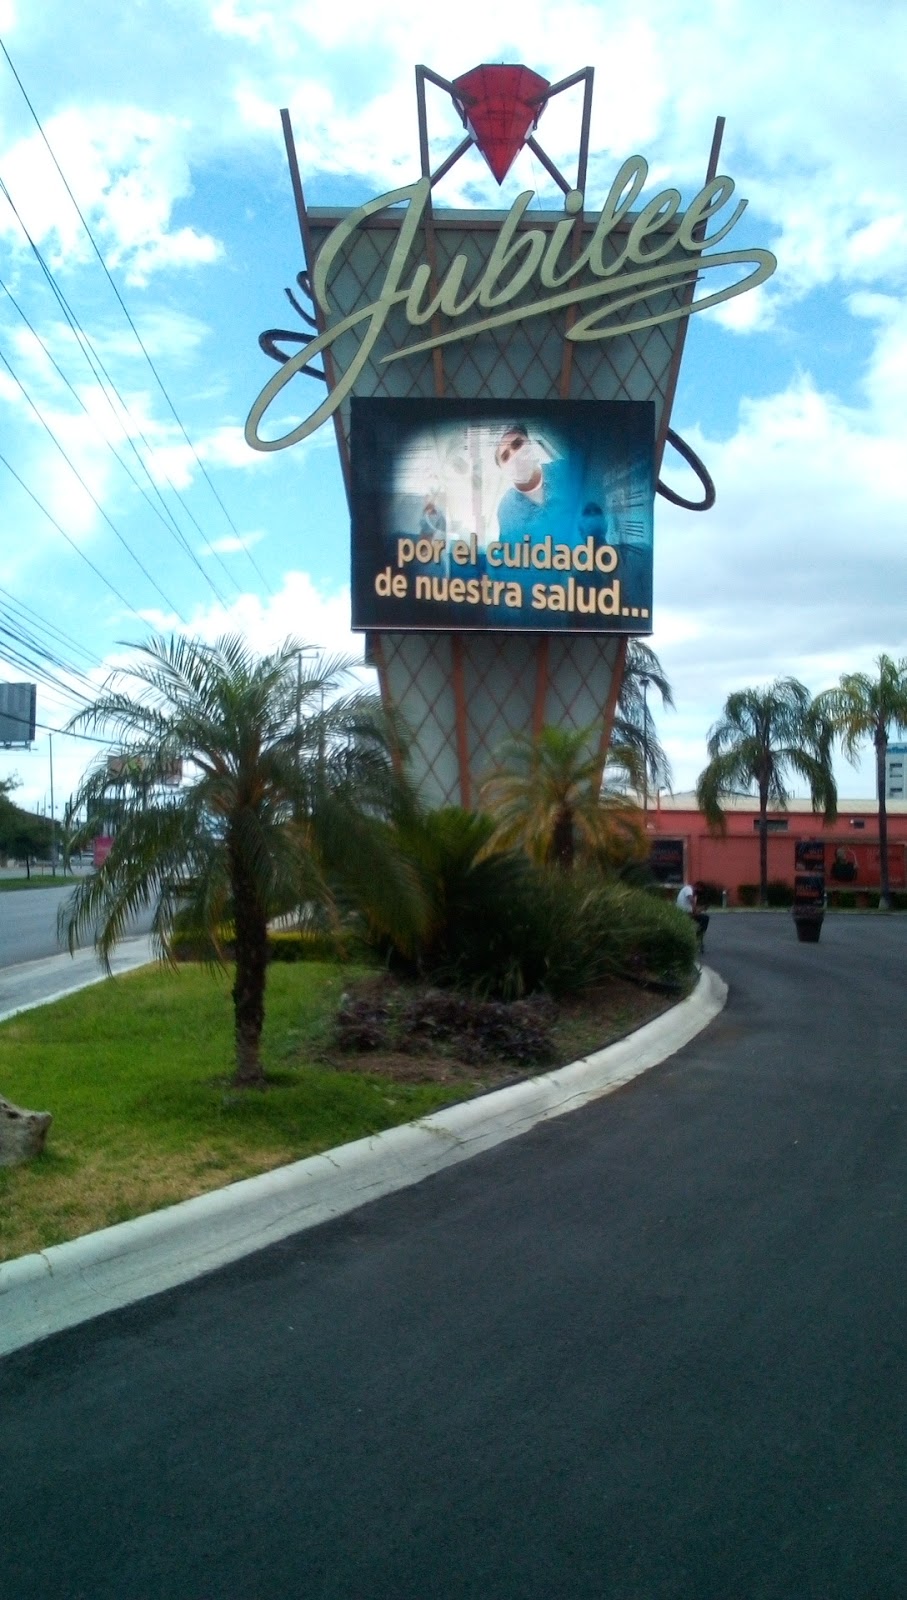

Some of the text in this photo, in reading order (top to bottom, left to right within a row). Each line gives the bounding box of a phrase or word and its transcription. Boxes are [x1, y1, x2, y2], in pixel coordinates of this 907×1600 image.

[244, 155, 777, 452] Jubilee
[397, 533, 618, 573] por el cuidado
[374, 567, 649, 618] de nuestra salud...
